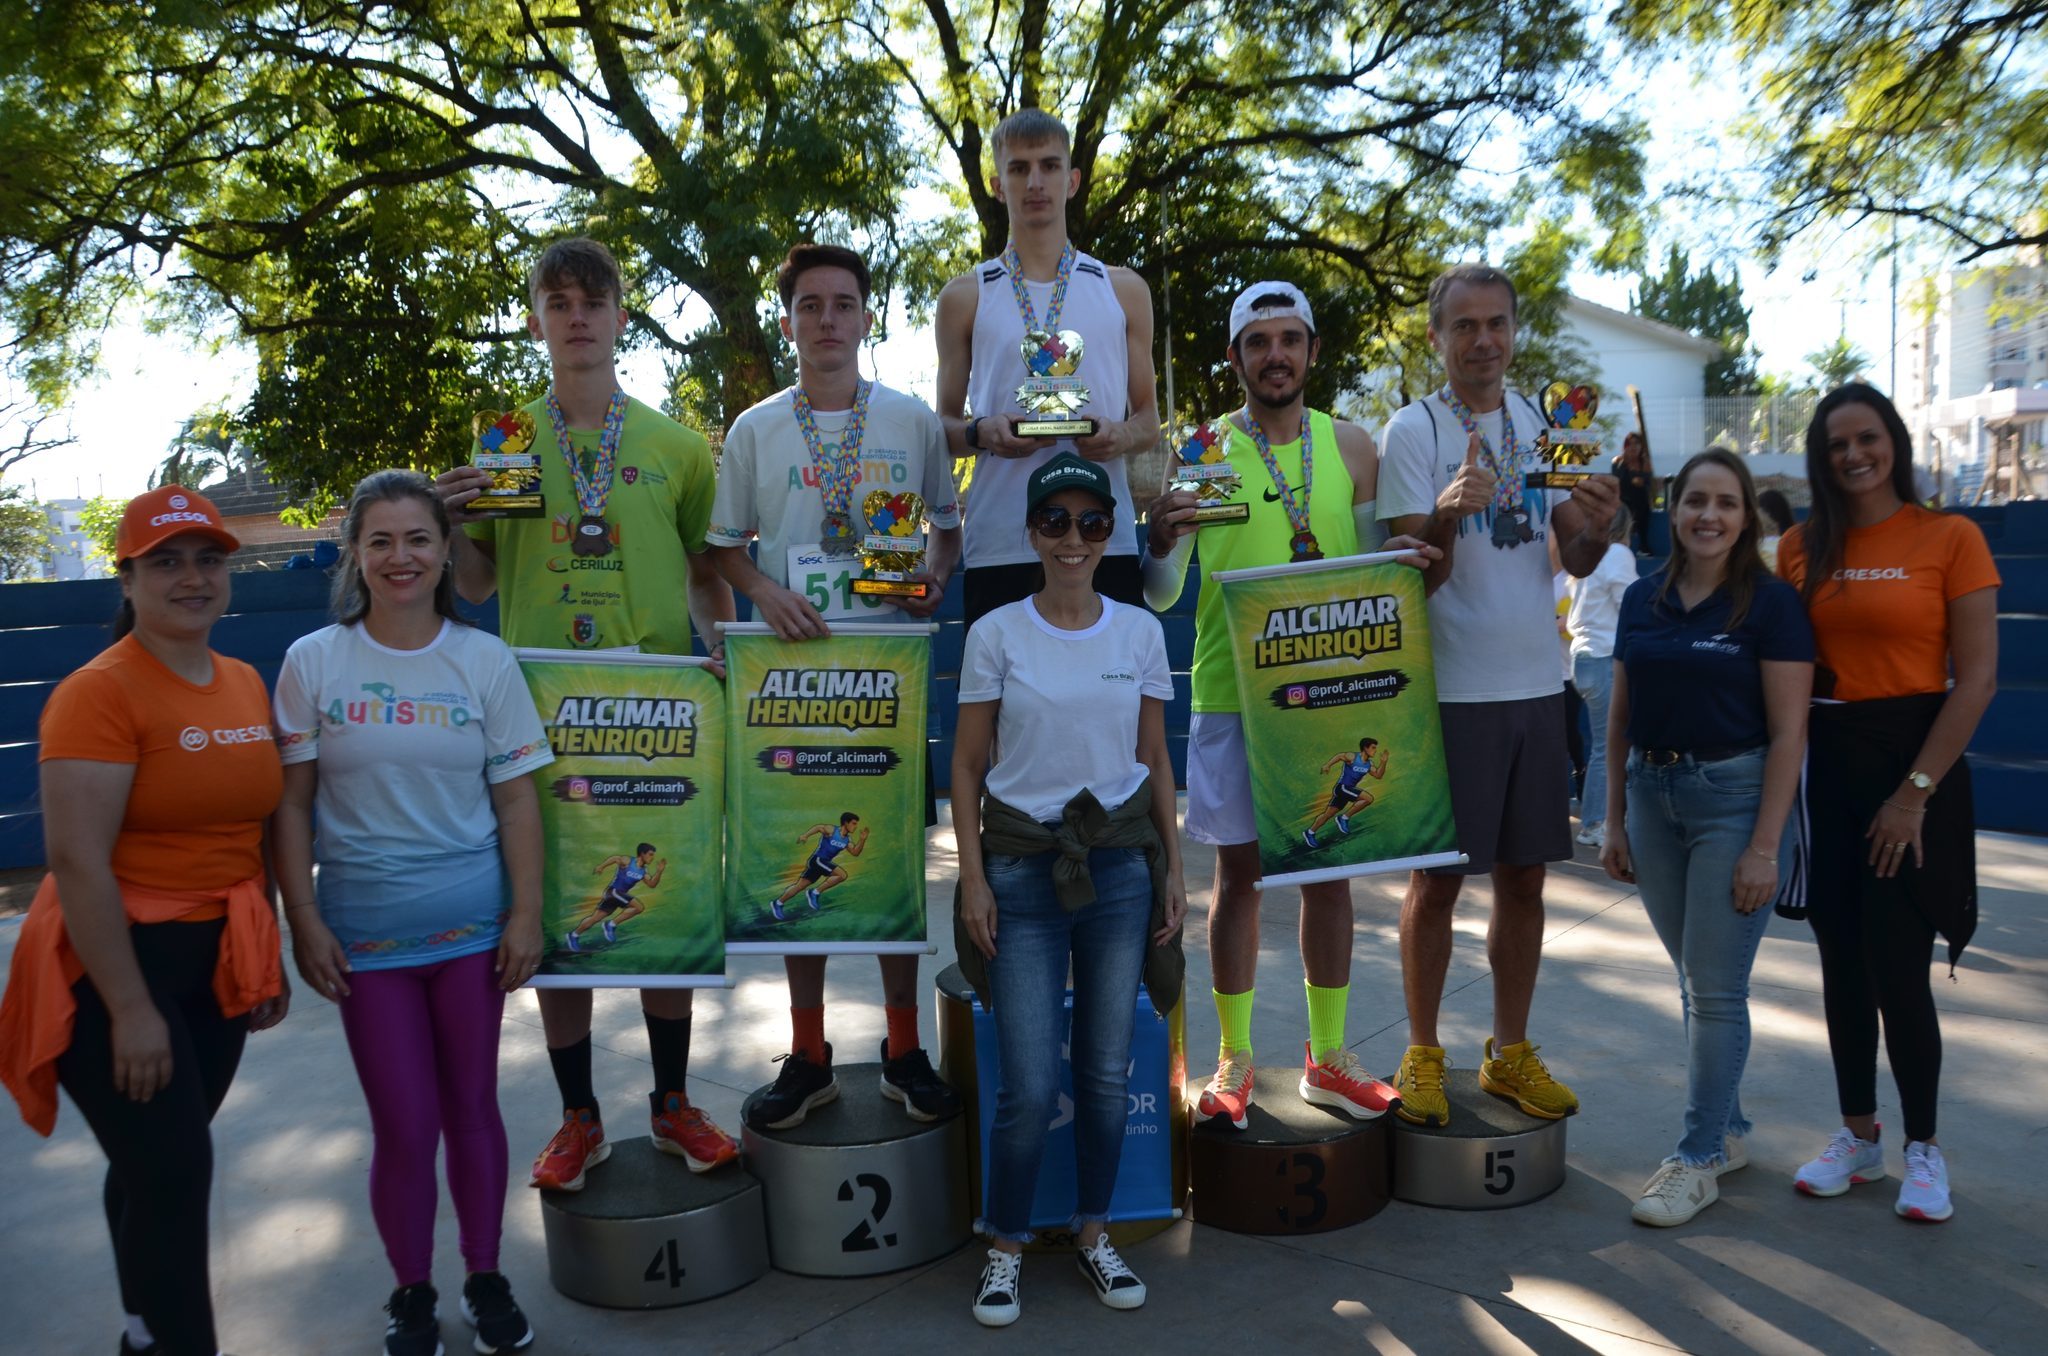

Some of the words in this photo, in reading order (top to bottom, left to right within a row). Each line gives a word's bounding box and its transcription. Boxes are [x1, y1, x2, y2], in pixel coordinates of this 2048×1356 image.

[1040, 469, 1063, 484] Casa
[1064, 466, 1098, 481] Branca
[151, 511, 213, 527] CRESOL
[570, 558, 624, 572] CERILUZ
[797, 555, 823, 566] Sesc
[1831, 567, 1911, 581] CRESOL
[1265, 596, 1397, 639] ALCIMAR
[1258, 624, 1398, 666] HENRIQUE
[760, 671, 897, 699] ALCIMAR
[1308, 675, 1397, 699] @prof_alcimarh
[1363, 691, 1393, 700] CORRIDA
[327, 697, 470, 728] Autismo
[556, 698, 694, 728] ALCIMAR
[750, 700, 895, 728] HENRIQUE
[547, 728, 694, 758] HENRIQUE
[795, 751, 887, 766] @prof_alcimarh
[591, 781, 685, 794] @prof_alcimarh
[1484, 1149, 1516, 1196] 5
[1275, 1152, 1328, 1229] 3
[837, 1172, 898, 1253] 2
[643, 1238, 686, 1289] 4
